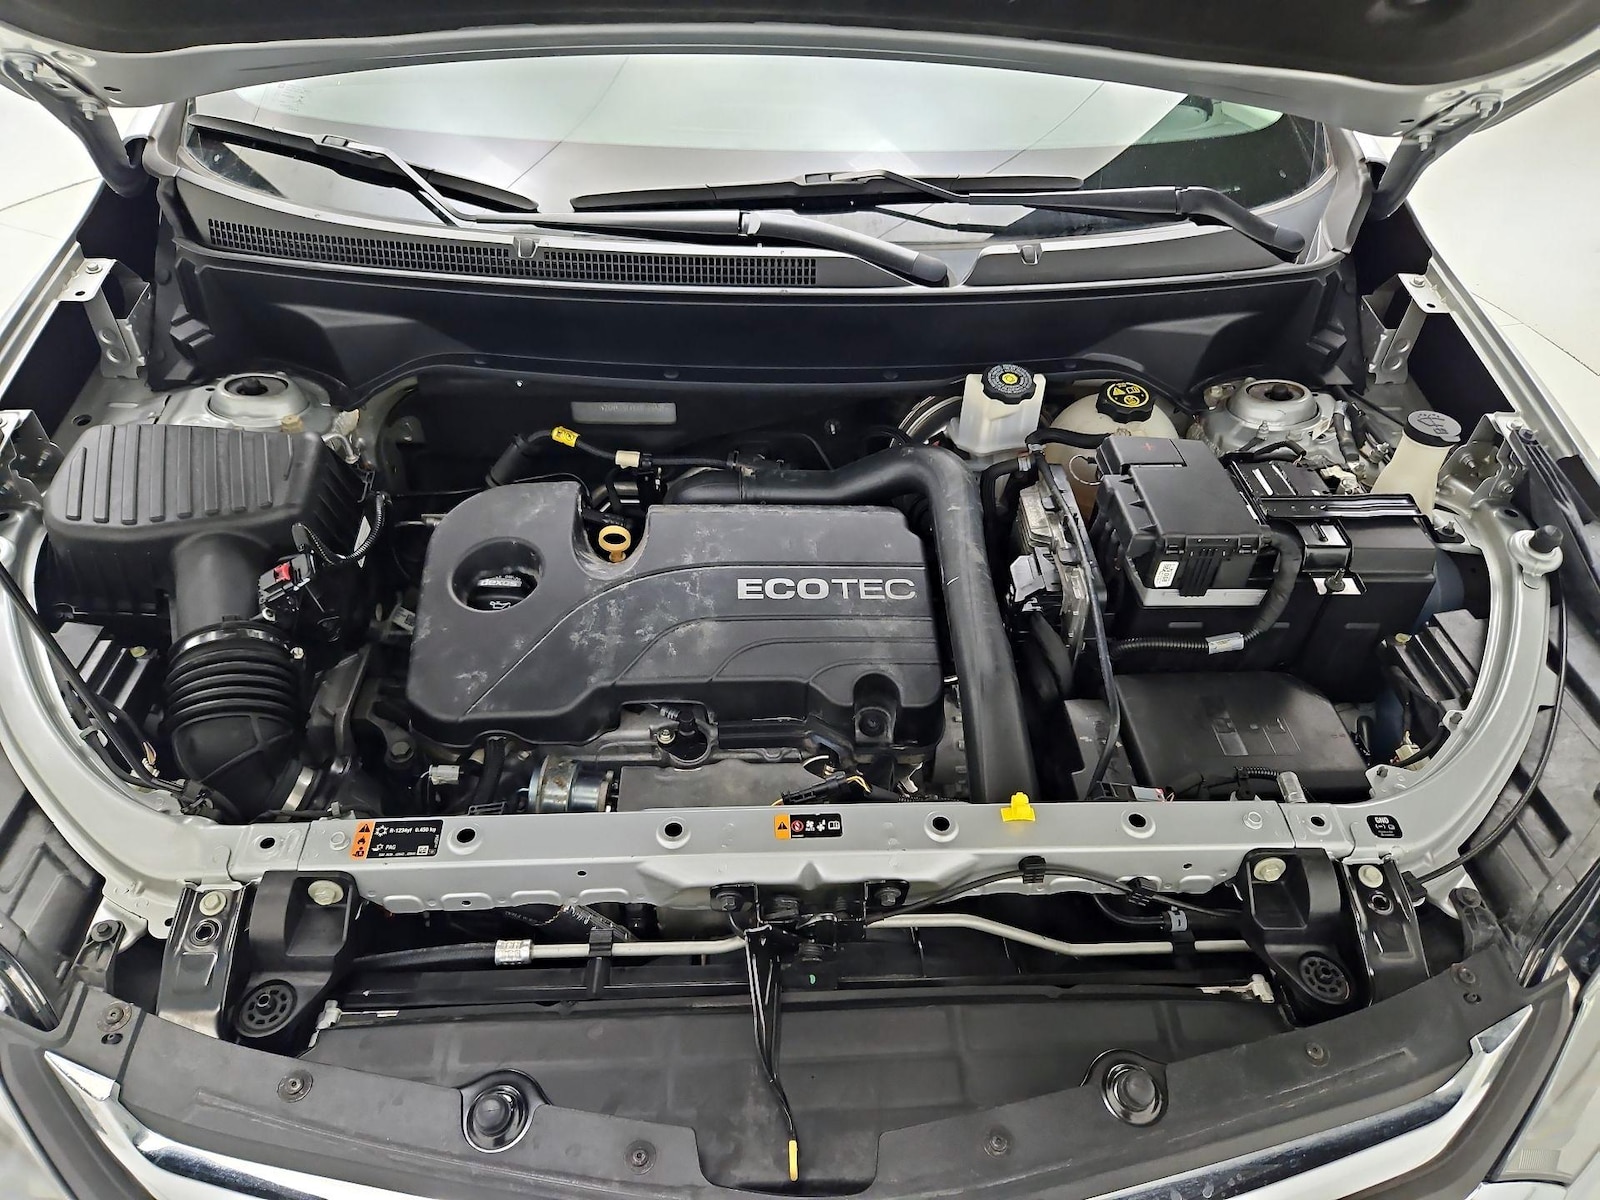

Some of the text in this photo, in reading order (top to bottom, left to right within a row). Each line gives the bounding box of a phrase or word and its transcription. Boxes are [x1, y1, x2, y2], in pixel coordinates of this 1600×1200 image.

[478, 578, 518, 587] dexos
[736, 577, 917, 600] ECOTEC
[1374, 816, 1390, 824] GND
[389, 826, 413, 834] R-1234yf
